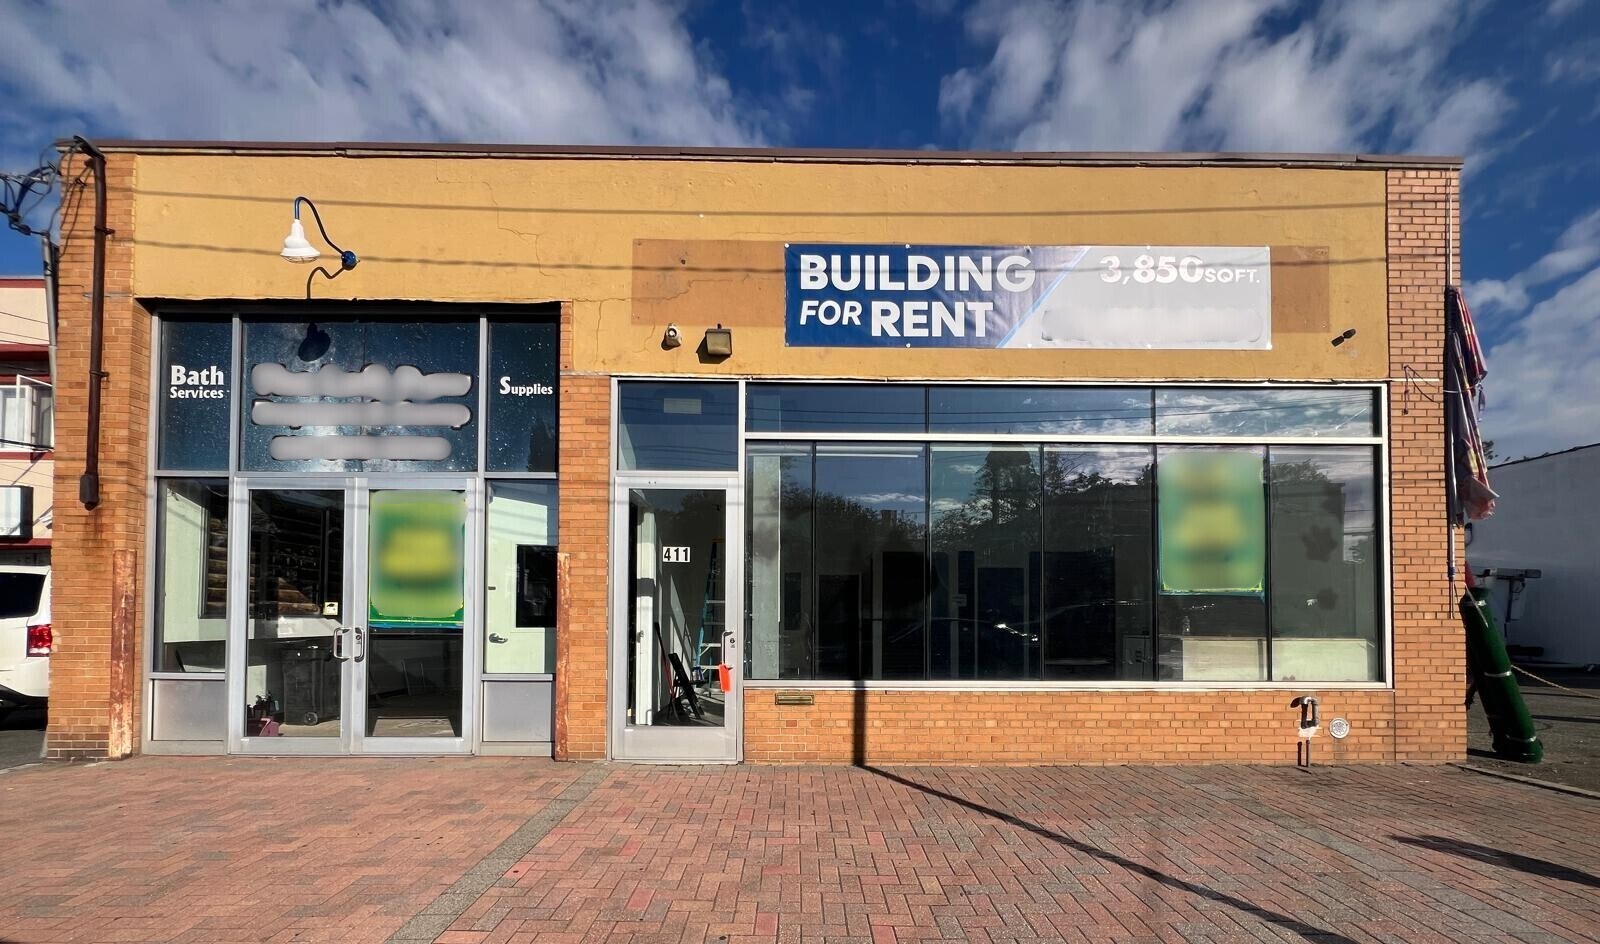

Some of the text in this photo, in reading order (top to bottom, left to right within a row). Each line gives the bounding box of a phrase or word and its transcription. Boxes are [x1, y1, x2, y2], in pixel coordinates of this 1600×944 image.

[800, 254, 1036, 293] BUILDING
[1099, 254, 1204, 285] 3,850
[800, 300, 994, 338] FOR RENT
[171, 365, 225, 386] Bath
[170, 386, 224, 399] Services
[500, 376, 553, 397] Supplies
[663, 547, 689, 562] 411
